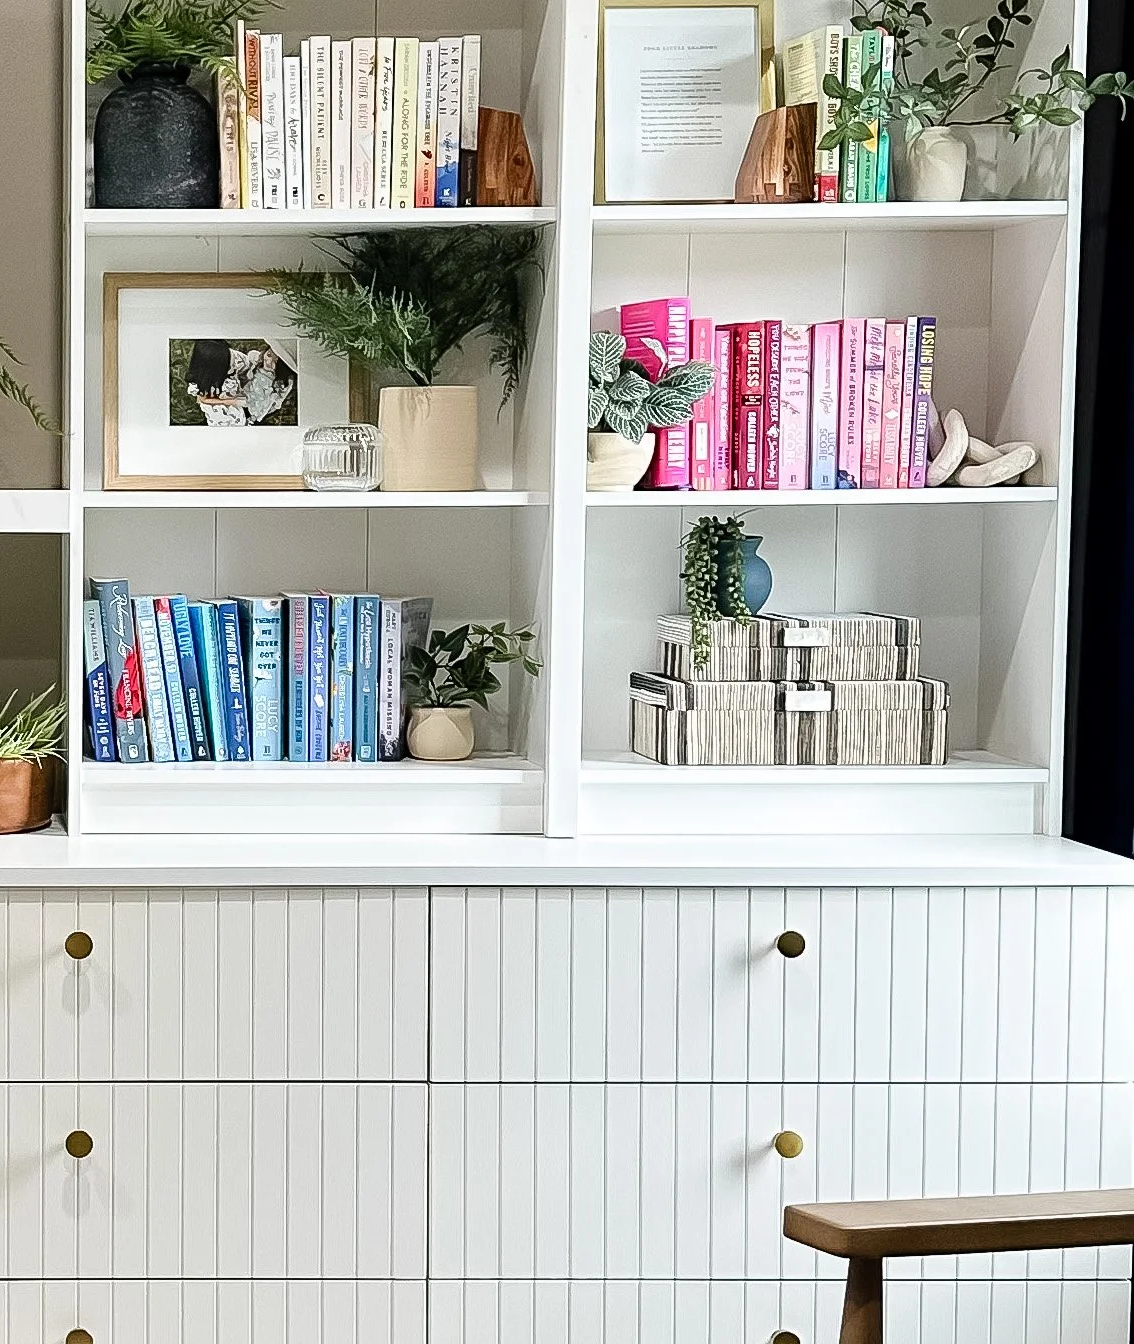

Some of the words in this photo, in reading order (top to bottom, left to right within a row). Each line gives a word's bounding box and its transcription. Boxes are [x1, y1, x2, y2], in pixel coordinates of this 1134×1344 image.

[248, 38, 257, 79] WITHOUT
[248, 80, 258, 110] RIVAL
[316, 67, 324, 98] SILENT
[439, 48, 448, 115] HANNAH
[450, 47, 459, 116] KRISTIN
[401, 98, 409, 130] ALONG
[444, 131, 452, 152] Night
[400, 170, 408, 188] RIDE
[668, 306, 687, 344] HAPPY
[747, 331, 761, 387] HOPELESS
[920, 325, 935, 364] LOSING
[769, 374, 779, 396] EACH
[918, 366, 933, 396] HOPE
[748, 411, 756, 442] COLLEEN
[916, 402, 928, 435] COLLEEN
[819, 428, 828, 461] SCORE
[174, 602, 188, 631] UGLY
[140, 620, 157, 654] BEACH
[178, 632, 192, 658] LOVE
[146, 656, 162, 690] READ
[170, 681, 182, 713] COLLEEN
[189, 688, 200, 715] COLLEEN
[255, 695, 266, 738] SCORE
[268, 699, 279, 732] LUCY
